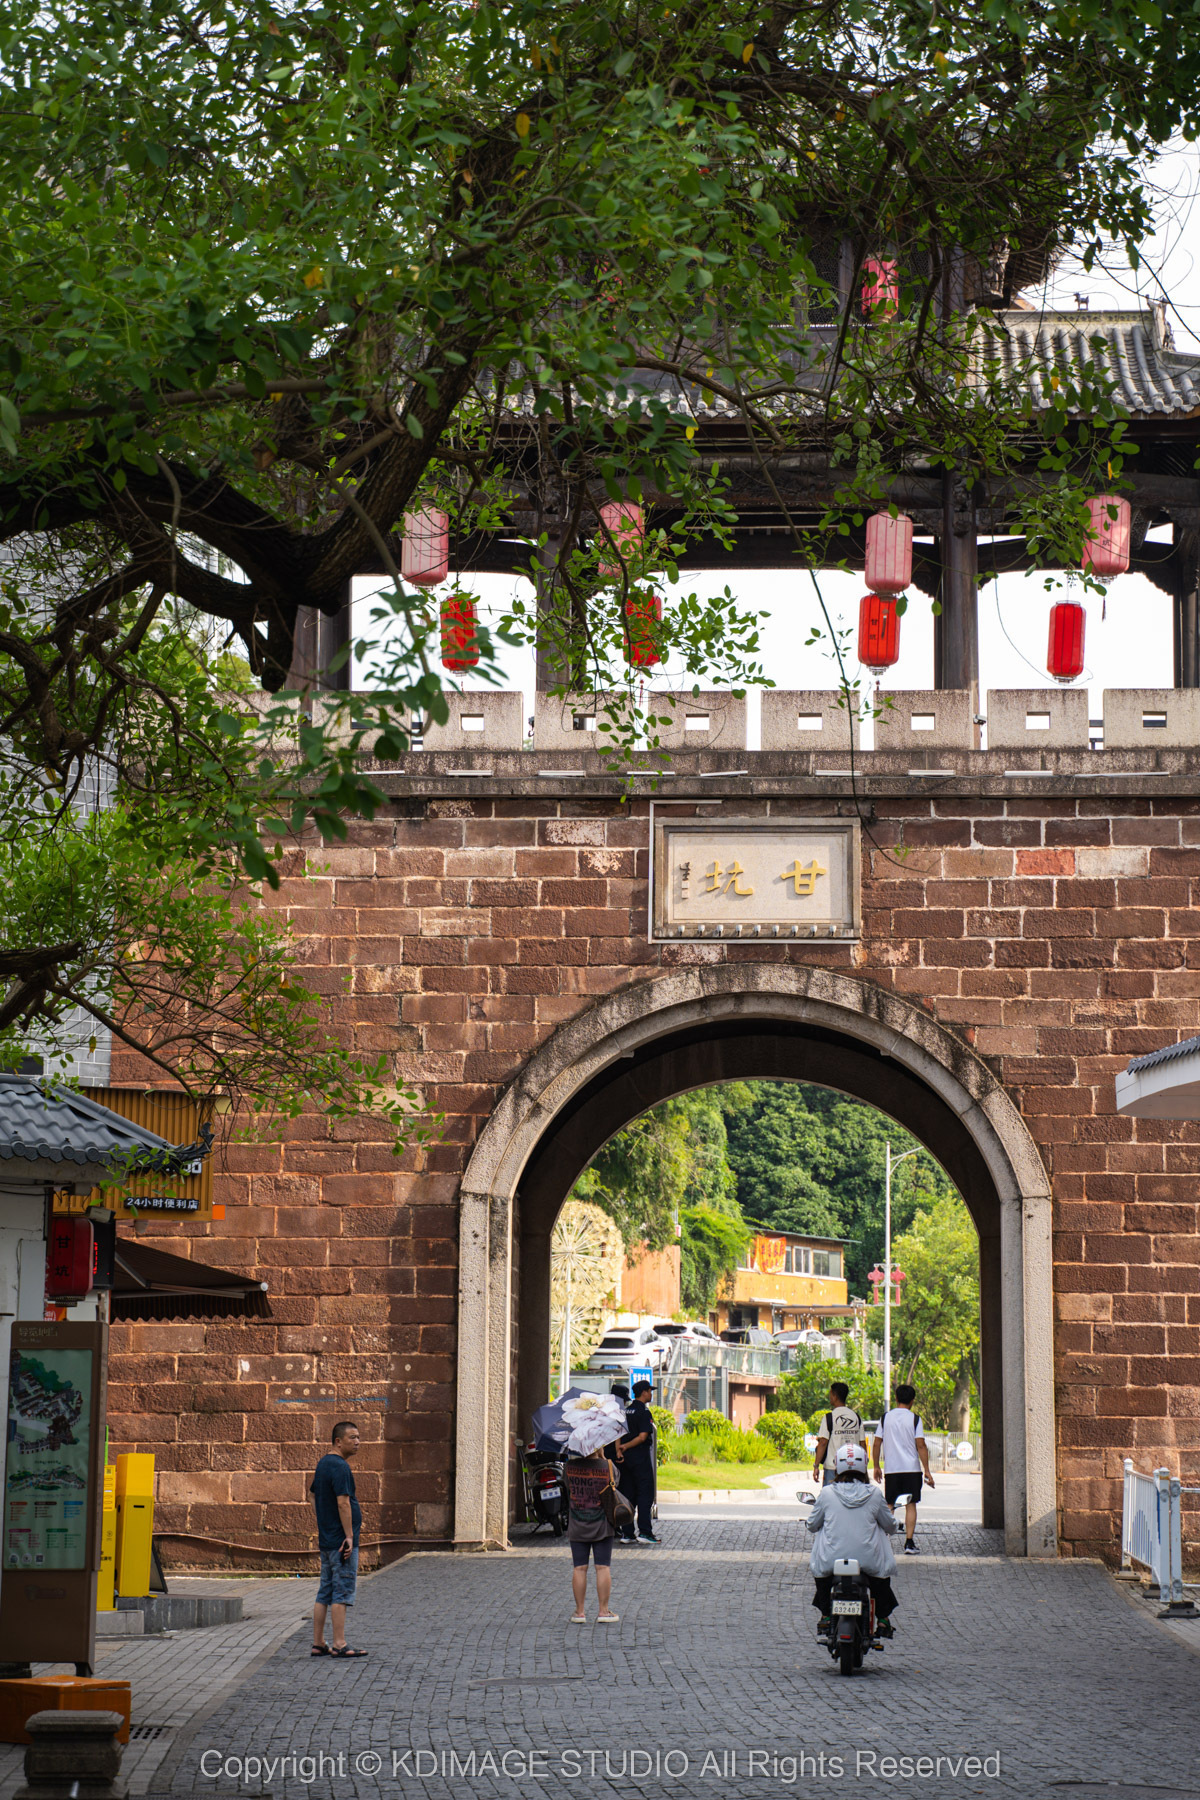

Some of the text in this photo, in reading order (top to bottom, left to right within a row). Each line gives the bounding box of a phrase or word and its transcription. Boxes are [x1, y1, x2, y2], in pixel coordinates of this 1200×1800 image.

[127, 1197, 200, 1210] 24小时便利店
[55, 1234, 71, 1277] 甘坑
